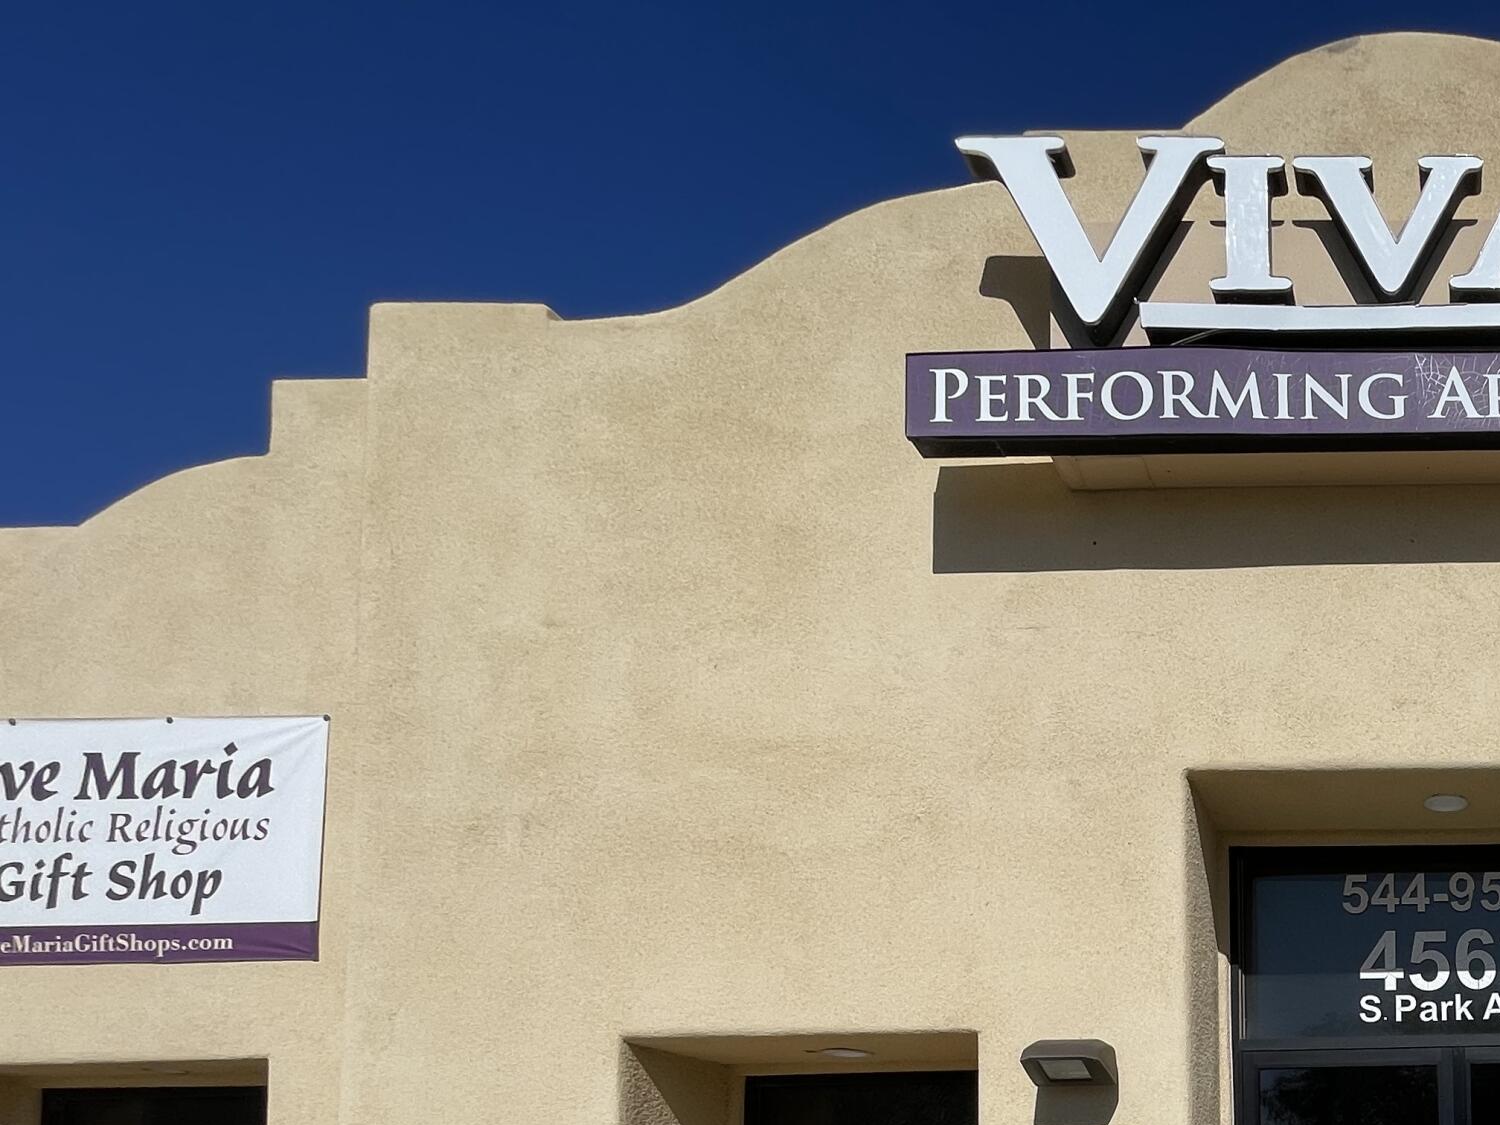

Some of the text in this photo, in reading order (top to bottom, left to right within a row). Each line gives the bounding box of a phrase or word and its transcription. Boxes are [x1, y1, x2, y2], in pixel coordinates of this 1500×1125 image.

[929, 364, 1406, 424] PERFORMING
[73, 742, 275, 801] Maria
[107, 805, 270, 855] Religious
[0, 852, 222, 916] Gift Shop
[1359, 995, 1388, 1023] S.
[1395, 994, 1474, 1023] Park
